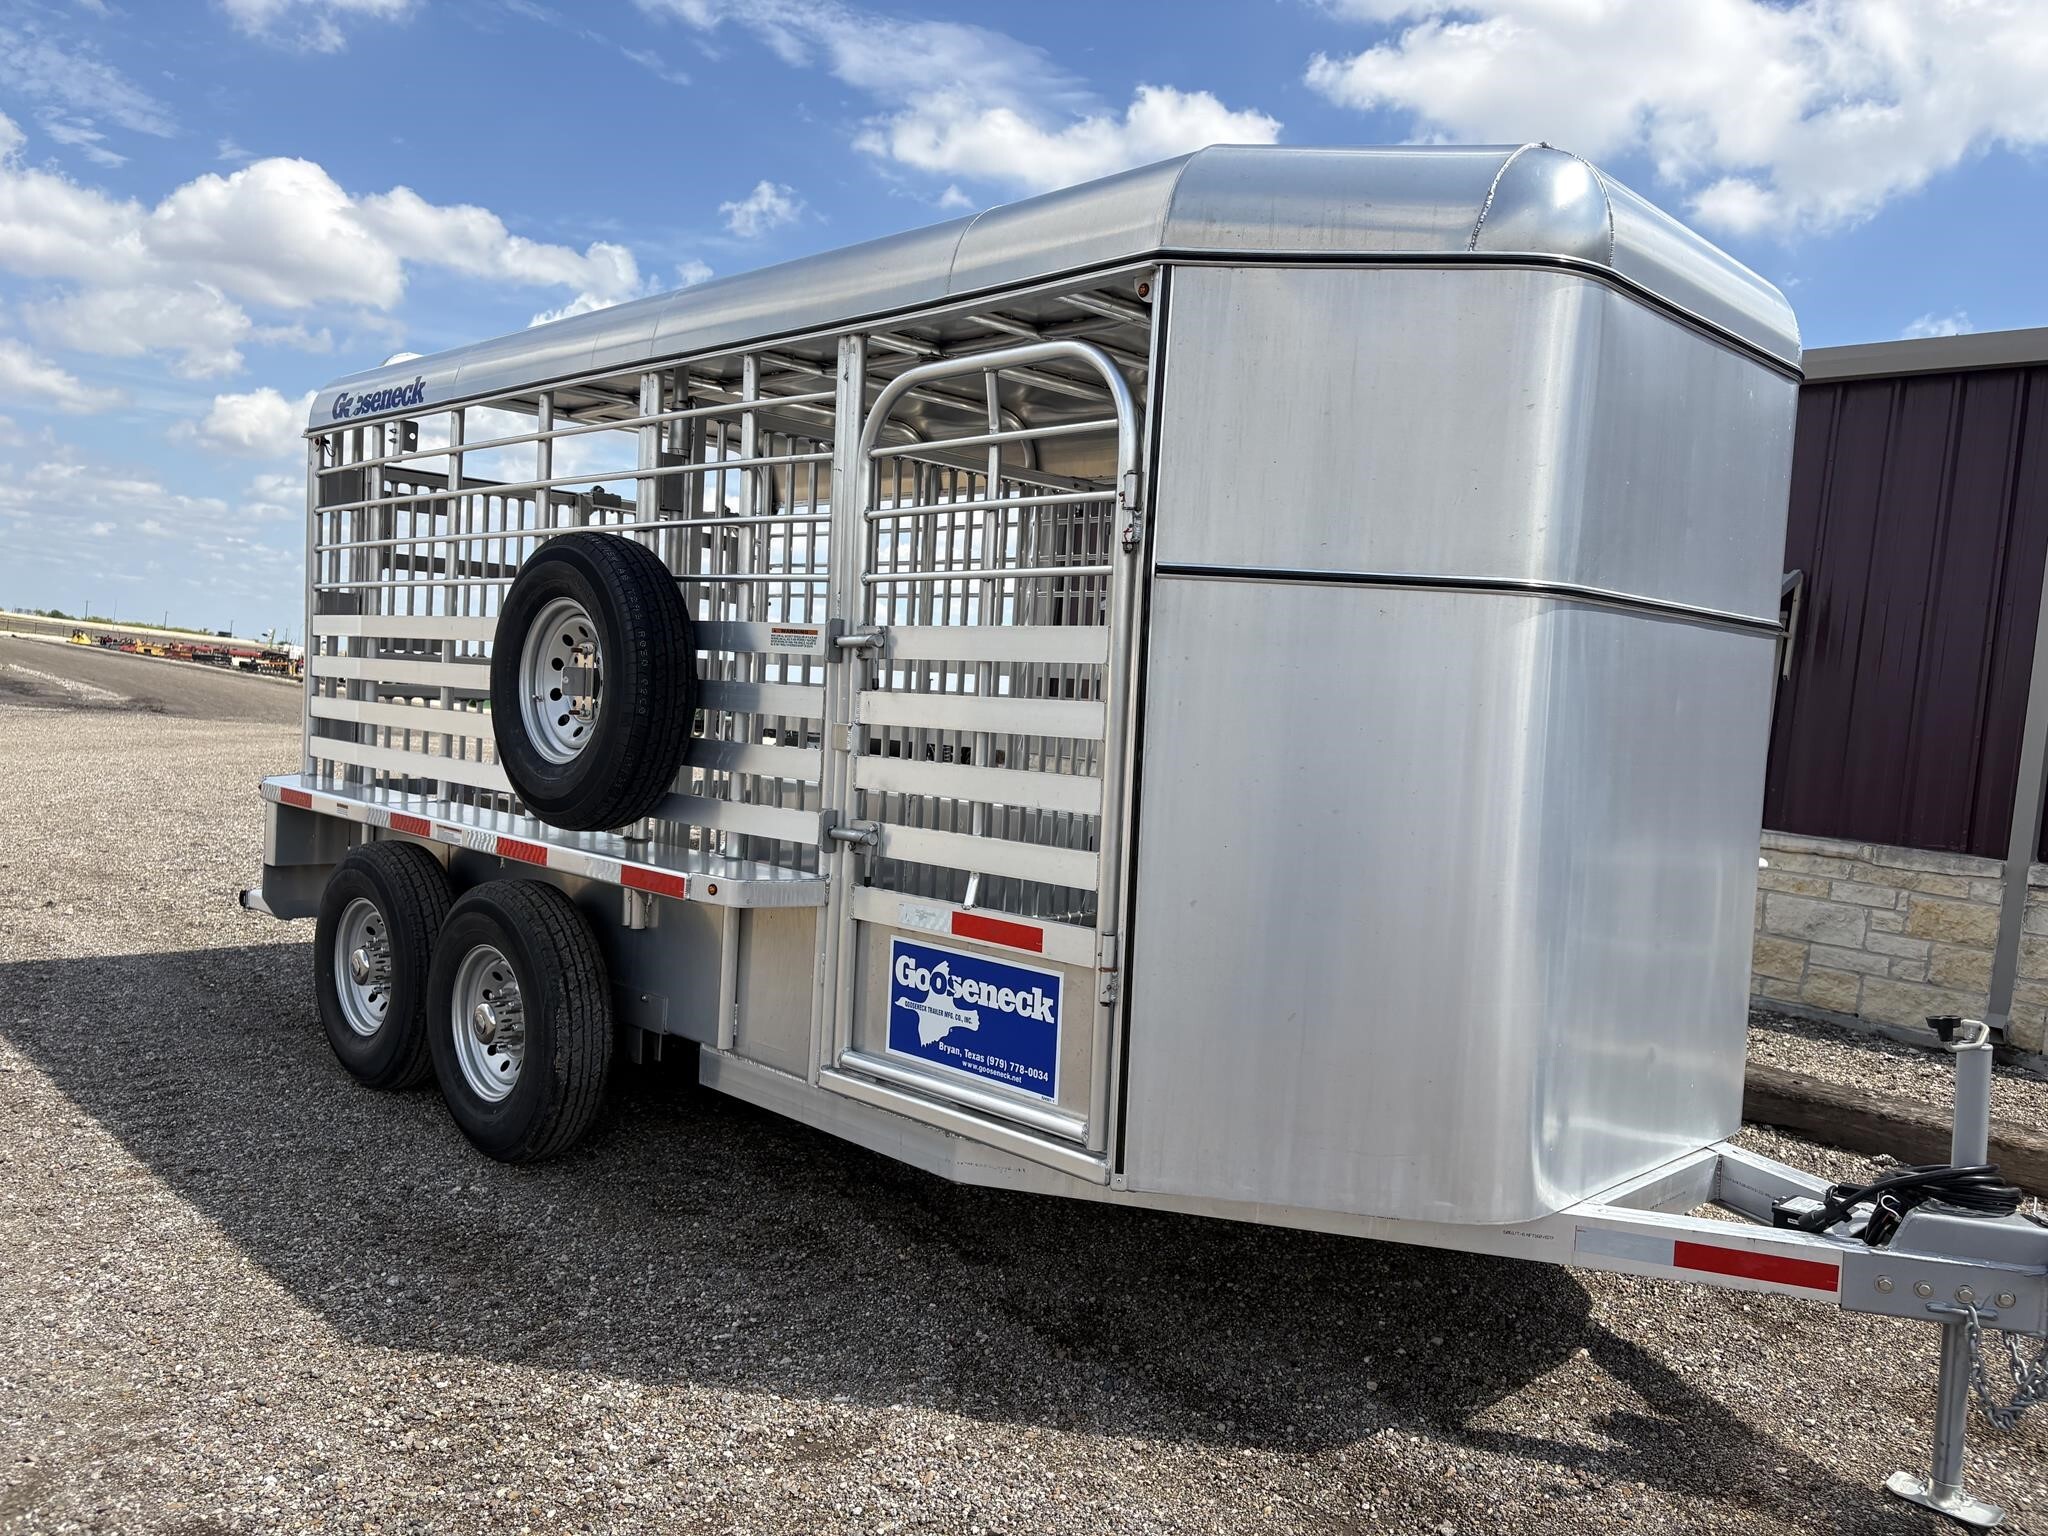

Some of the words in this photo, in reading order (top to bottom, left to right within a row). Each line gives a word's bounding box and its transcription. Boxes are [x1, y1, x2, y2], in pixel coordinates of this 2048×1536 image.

[332, 376, 426, 419] Gooseneck
[895, 955, 1055, 1024] Gooseneck
[904, 1000, 927, 1012] GOOSENECK
[928, 1006, 943, 1016] TRAILER
[944, 1011, 954, 1020] MFG.
[938, 1041, 962, 1058] Bryan,
[964, 1048, 985, 1063] Texas
[986, 1055, 1007, 1071] (979)
[1009, 1062, 1049, 1082] 778-0034
[962, 1060, 1022, 1083] www.gooseneck.net
